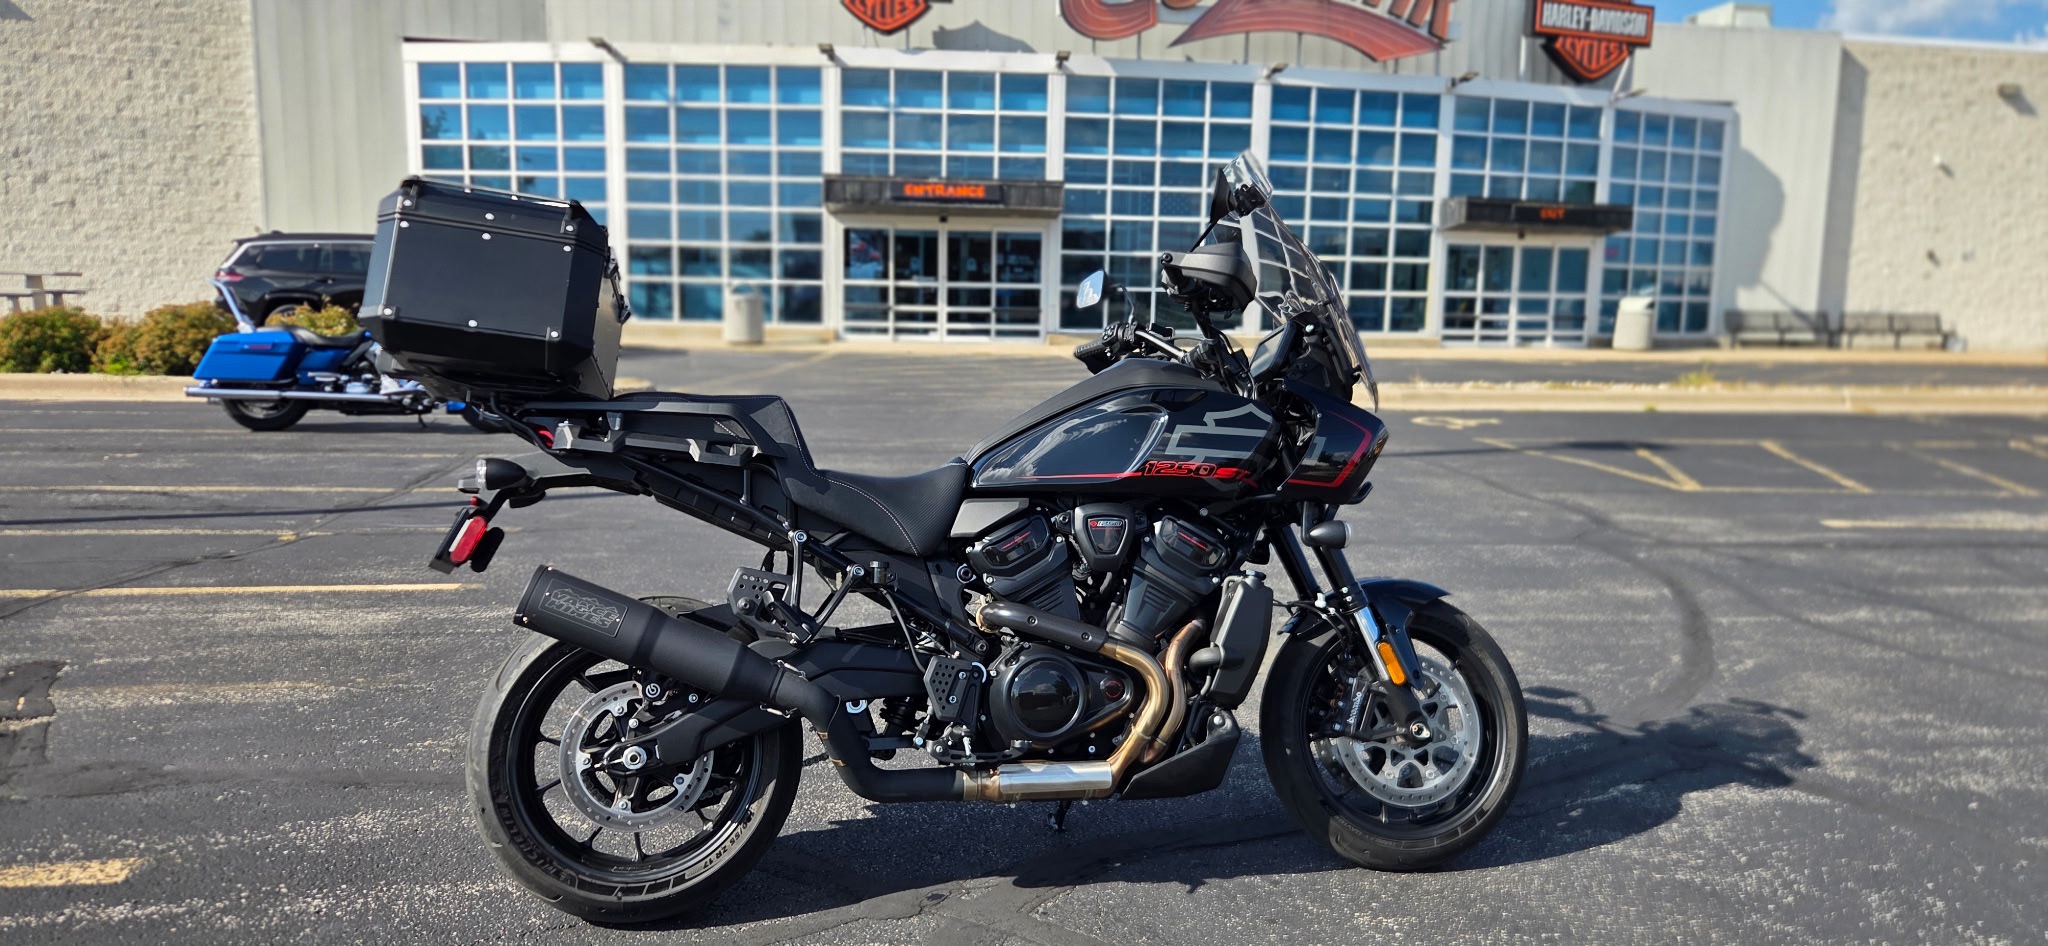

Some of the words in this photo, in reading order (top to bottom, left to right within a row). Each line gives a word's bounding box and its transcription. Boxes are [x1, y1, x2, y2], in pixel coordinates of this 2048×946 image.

[904, 183, 986, 198] ENTRANCE
[1143, 460, 1217, 478] 1250
[545, 600, 612, 628] HINES
[551, 590, 619, 619] VANCE
[1346, 691, 1362, 724] brembo
[501, 805, 558, 875] MICHELIN
[702, 858, 714, 869] 17
